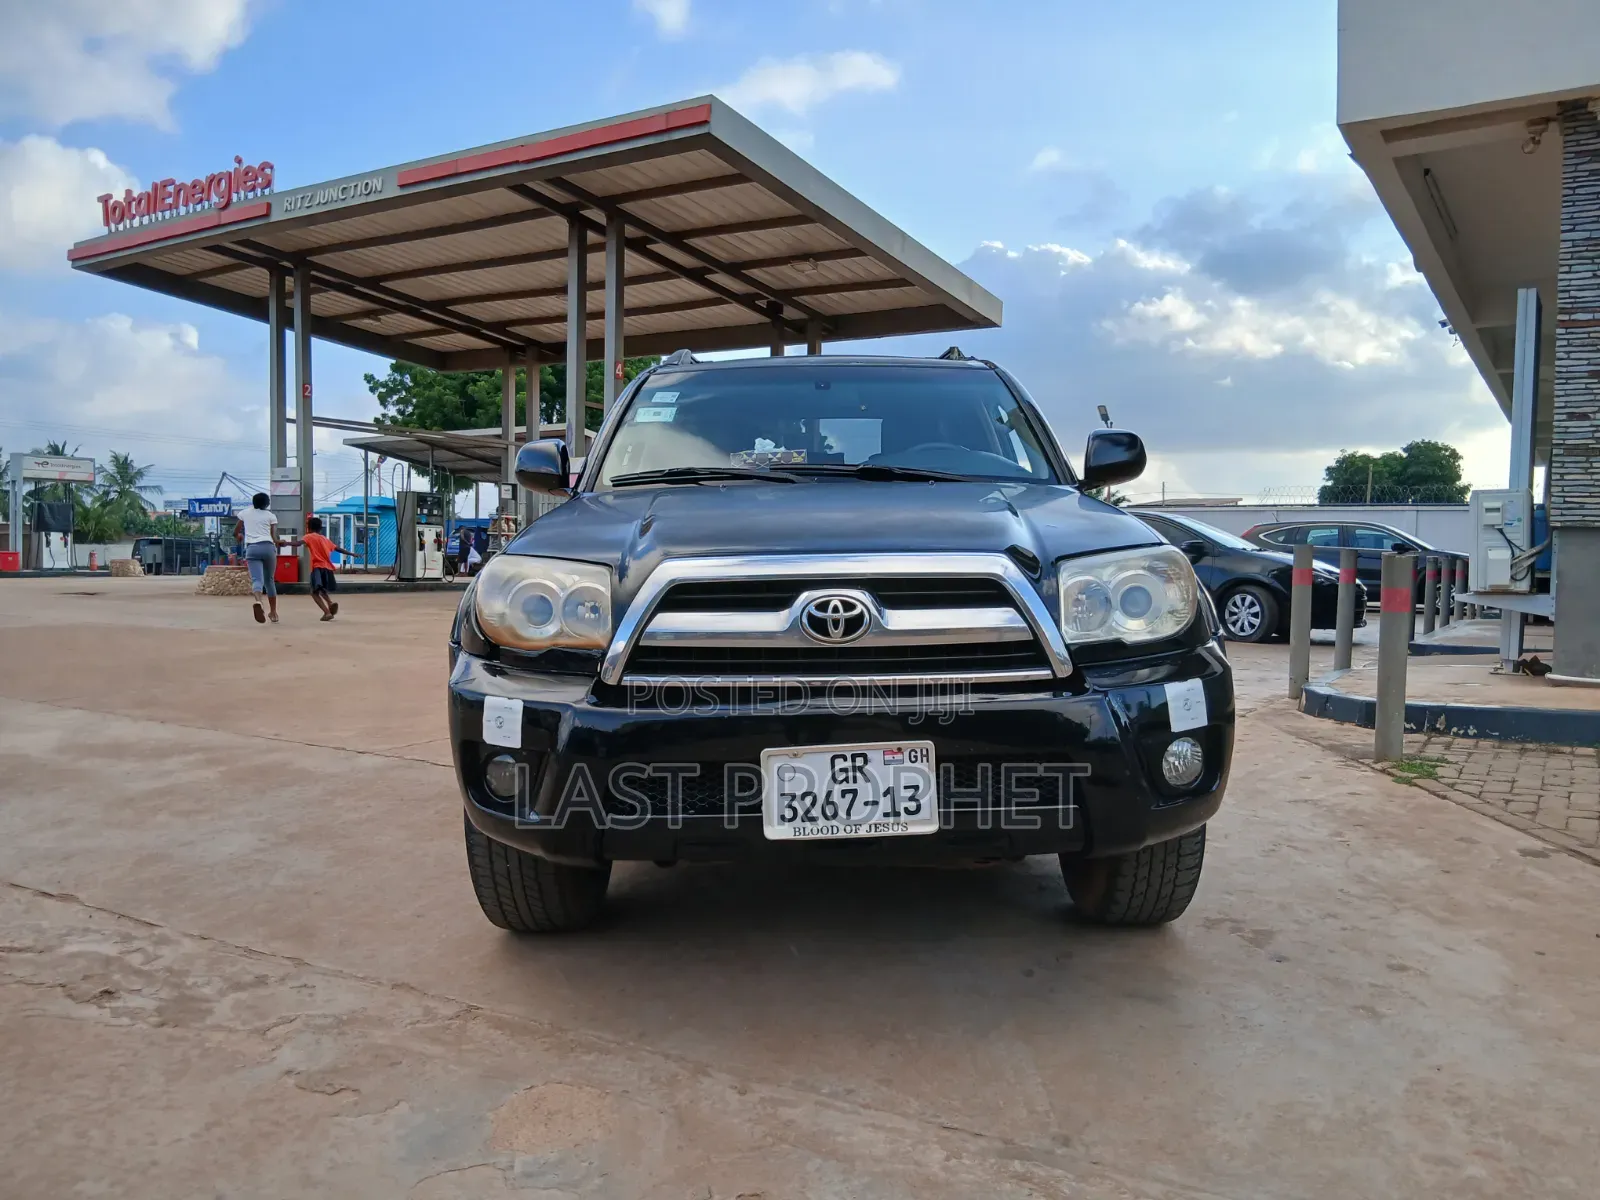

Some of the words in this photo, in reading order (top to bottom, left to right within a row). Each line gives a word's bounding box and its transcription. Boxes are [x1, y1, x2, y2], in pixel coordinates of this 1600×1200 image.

[97, 155, 275, 227] TotalEnergies
[283, 191, 314, 212] RITZ
[315, 176, 384, 206] JUNCTION
[615, 363, 623, 377] 4
[304, 384, 312, 396] 2
[195, 501, 230, 515] Laundry
[908, 748, 930, 764] GH
[830, 752, 871, 785] GR
[779, 784, 922, 823] 3267-13
[793, 824, 840, 837] BLOOD
[843, 823, 863, 834] OF
[865, 822, 909, 834] JESUS
